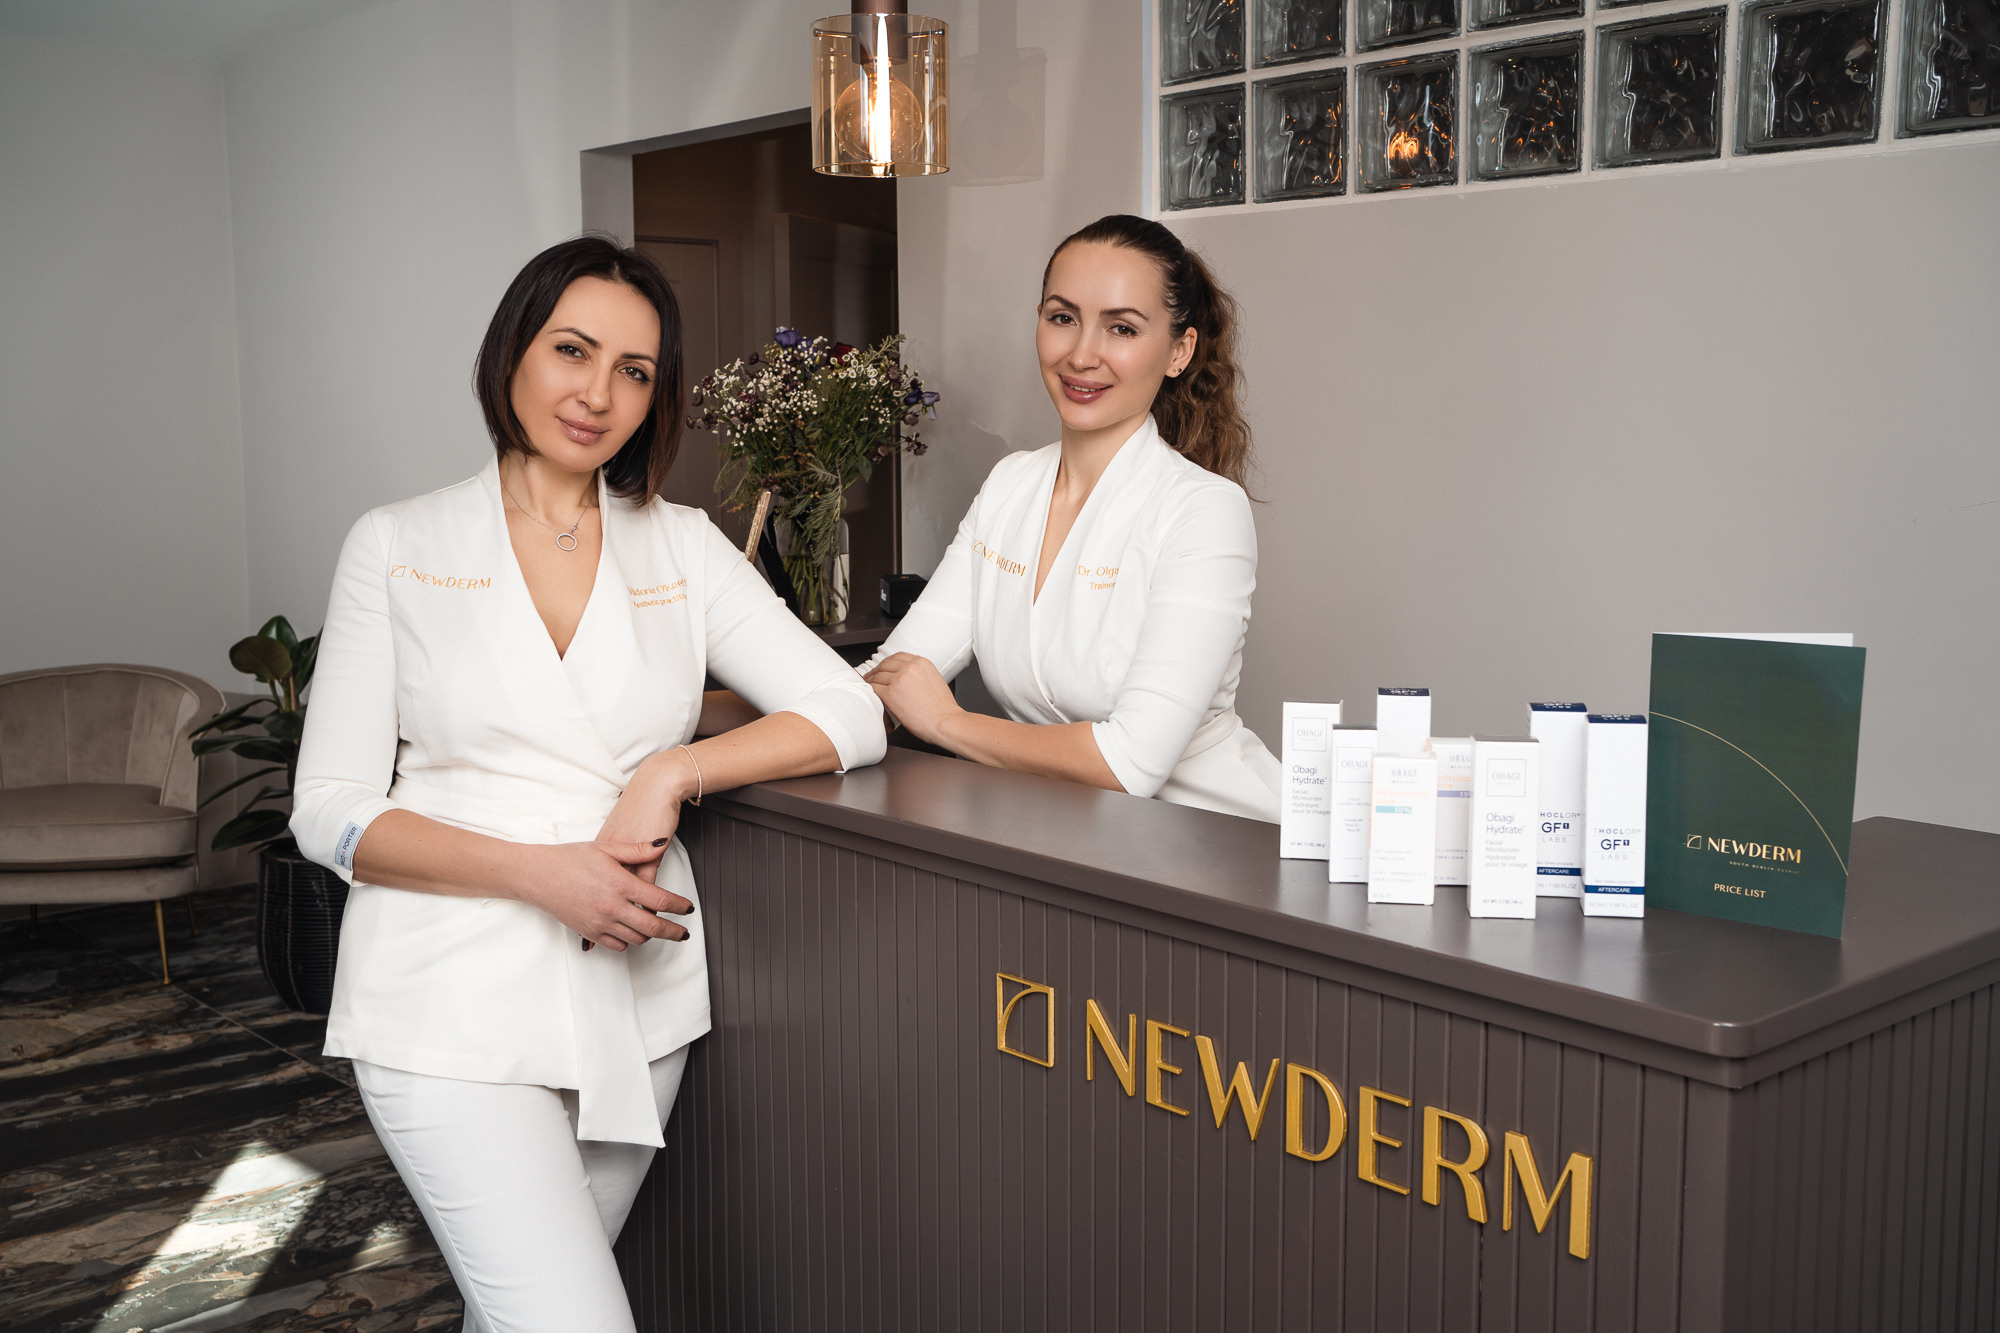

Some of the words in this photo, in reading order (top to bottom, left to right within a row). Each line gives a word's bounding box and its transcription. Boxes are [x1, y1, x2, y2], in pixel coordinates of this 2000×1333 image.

[1078, 564, 1093, 577] Dr.
[1096, 566, 1119, 579] Olga
[409, 568, 491, 590] NEWDERM
[1296, 729, 1323, 738] OBAGI
[1341, 760, 1368, 769] OBAGI
[1449, 754, 1470, 763] OBAG
[1292, 764, 1318, 777] Obagi
[1391, 768, 1416, 778] OBAGI
[1491, 772, 1520, 781] OBAGI
[1485, 812, 1515, 825] Obagi
[343, 826, 358, 851] PORTER
[1707, 836, 1801, 864] NEWDERM
[1485, 854, 1516, 862] Hydratant
[1729, 860, 1749, 868] SOUTH
[1714, 883, 1742, 895] PRICE
[1744, 887, 1767, 899] LIST
[1086, 998, 1592, 1260] NEWDERM
